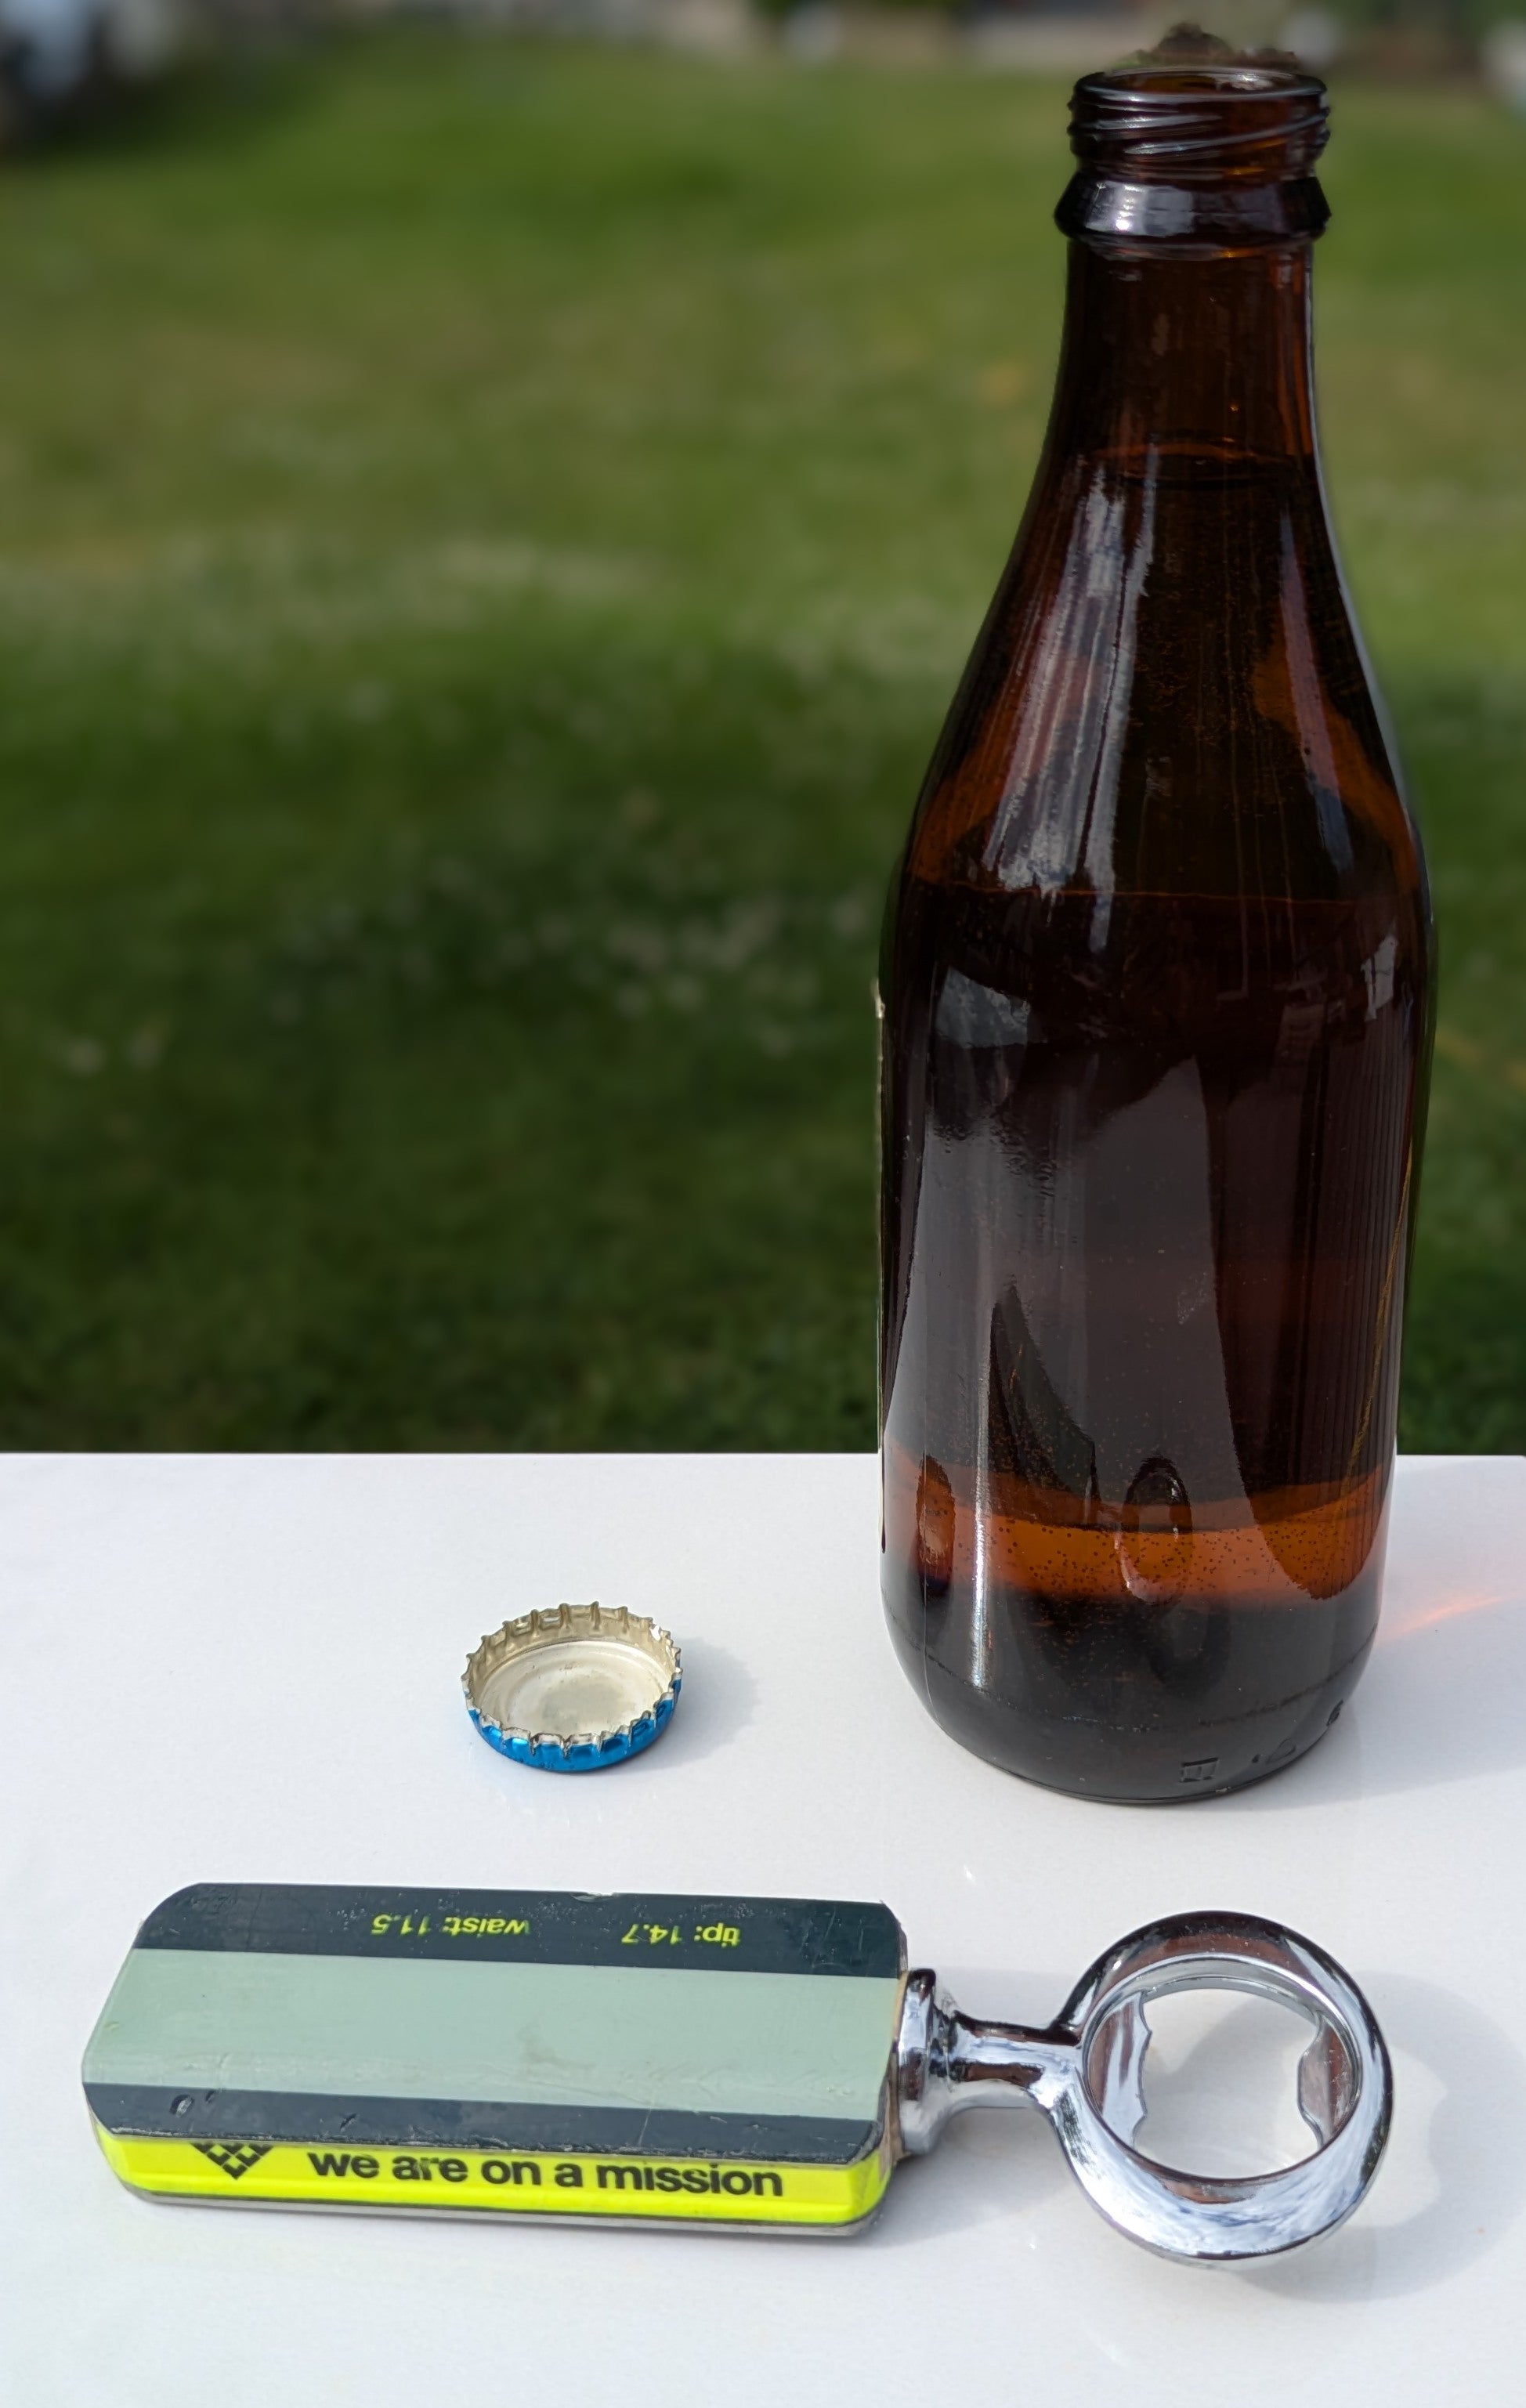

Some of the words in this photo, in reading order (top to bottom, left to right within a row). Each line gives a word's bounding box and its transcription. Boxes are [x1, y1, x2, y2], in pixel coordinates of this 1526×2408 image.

[371, 1913, 431, 1936] 11.5
[441, 1916, 530, 1939] waist:
[620, 1923, 684, 1944] 14.7
[693, 1922, 741, 1947] tip:
[306, 2152, 380, 2178] we
[392, 2155, 468, 2182] are
[481, 2160, 542, 2186] on
[554, 2163, 584, 2188] a
[596, 2162, 783, 2196] mission
